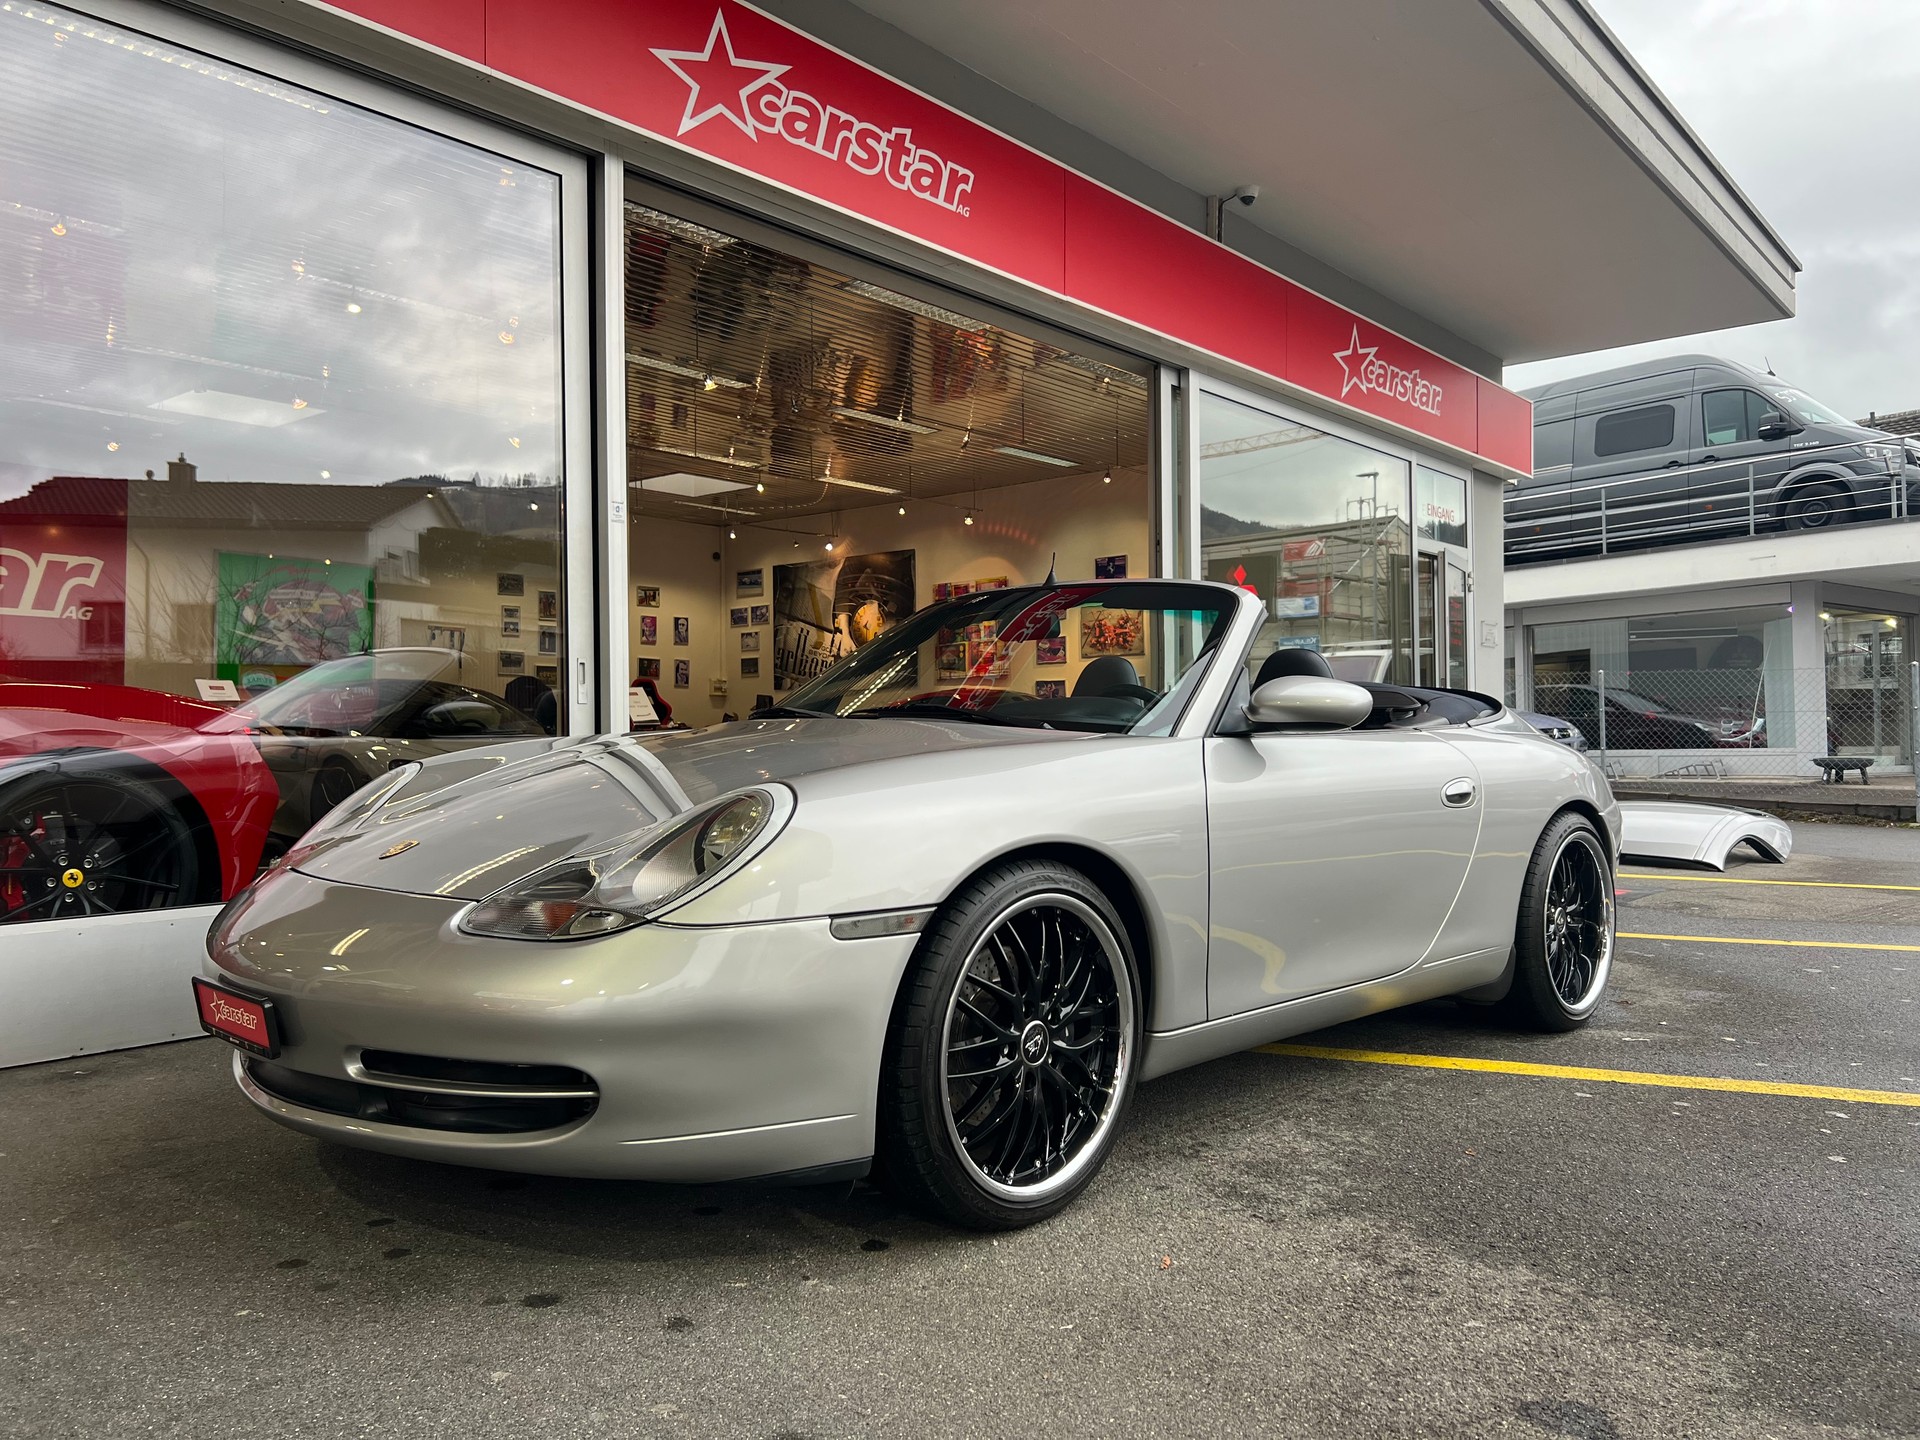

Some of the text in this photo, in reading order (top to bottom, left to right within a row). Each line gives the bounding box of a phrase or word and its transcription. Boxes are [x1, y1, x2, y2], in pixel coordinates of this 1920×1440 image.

[748, 77, 975, 218] carstar AG
[1364, 355, 1443, 415] carstar
[1426, 503, 1455, 523] EINGANG
[62, 606, 94, 621] AG
[221, 1004, 257, 1030] carstar
